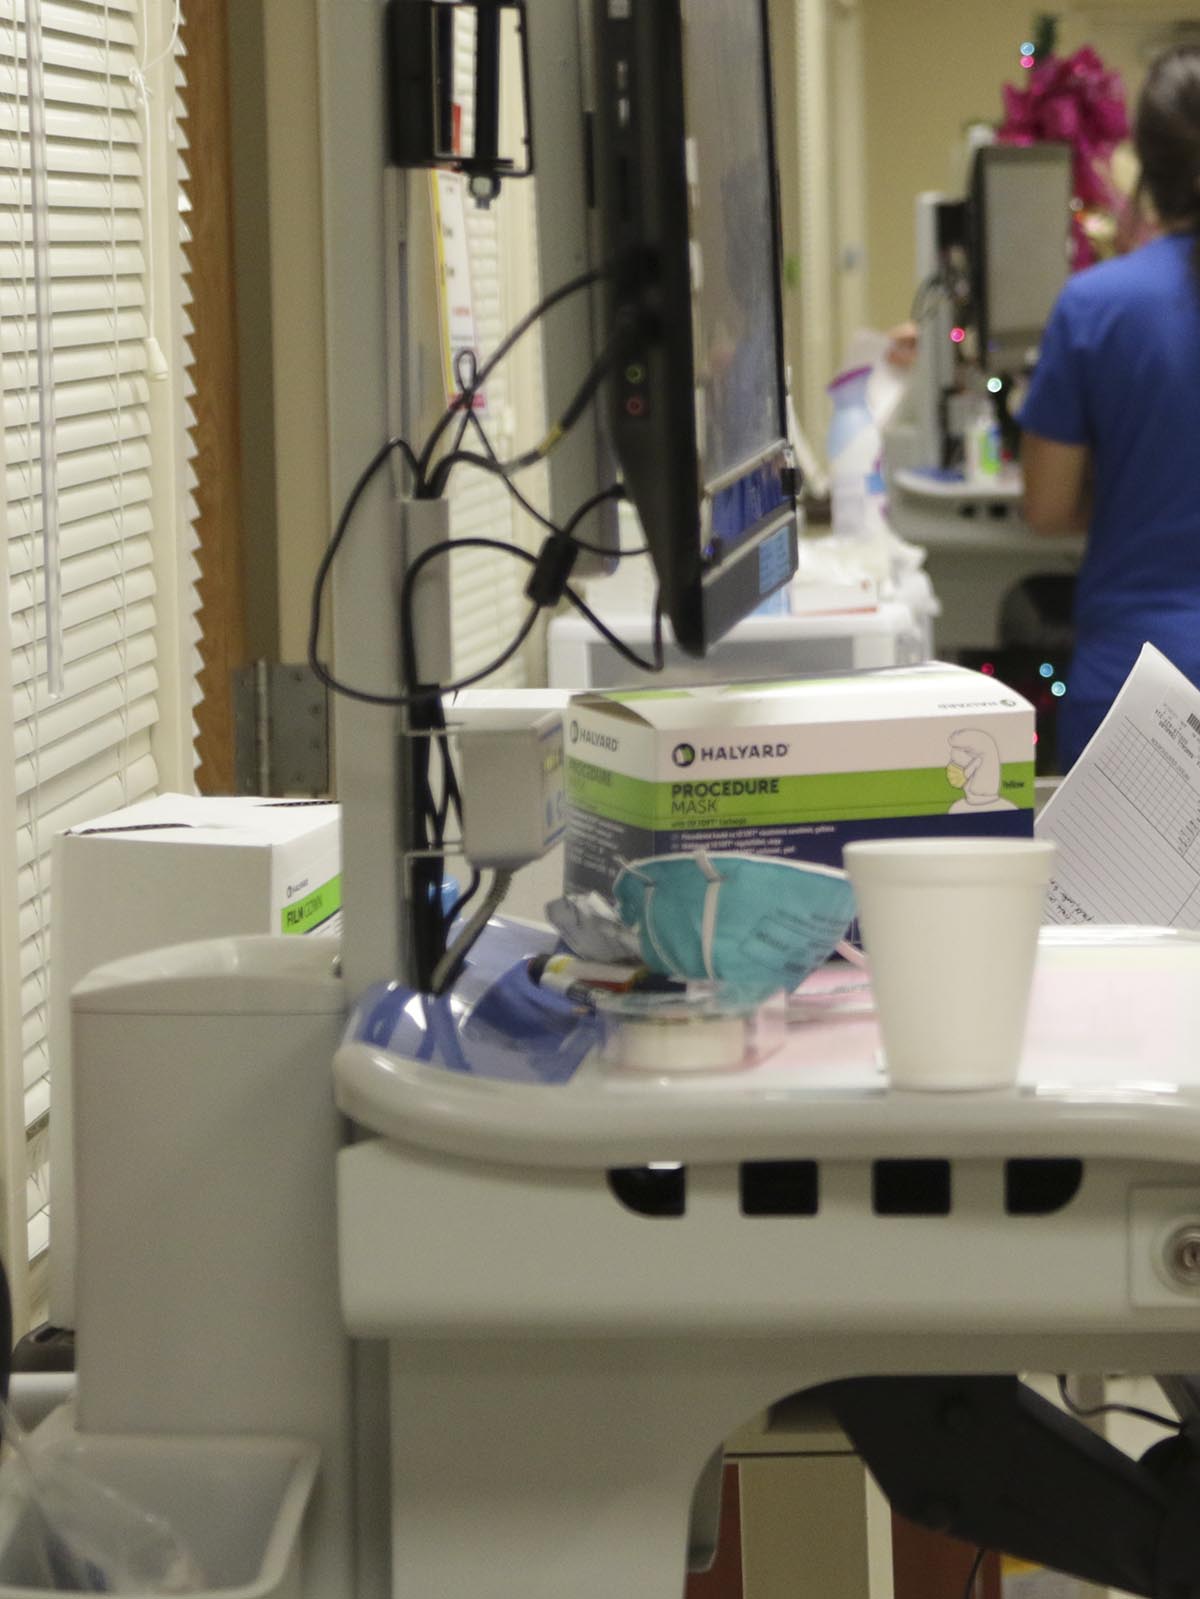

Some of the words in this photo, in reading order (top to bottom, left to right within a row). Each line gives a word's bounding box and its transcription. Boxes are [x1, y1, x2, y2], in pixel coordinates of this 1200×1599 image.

[579, 730, 618, 752] HALYARD
[701, 744, 788, 761] HALYARD
[672, 779, 780, 799] PROCEDURE
[672, 799, 717, 815] MASK
[287, 905, 304, 927] FILM
